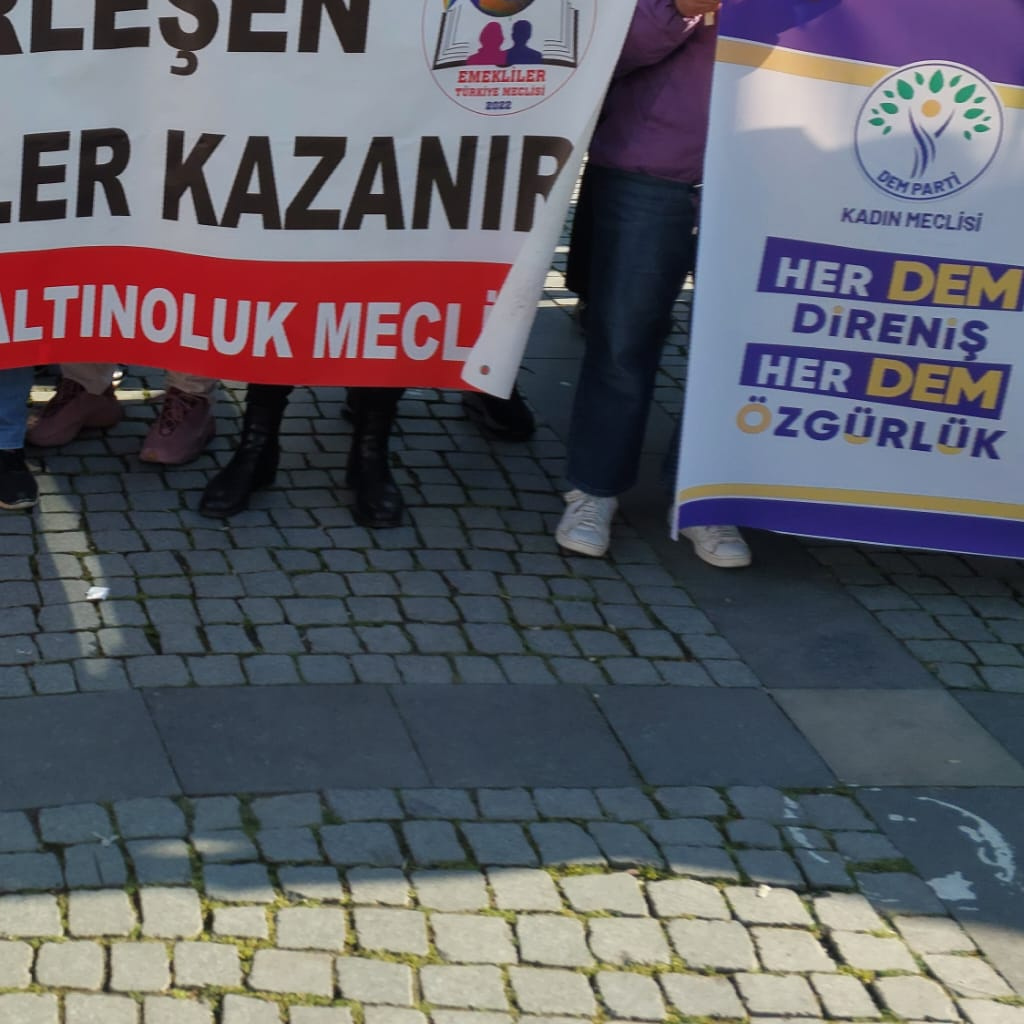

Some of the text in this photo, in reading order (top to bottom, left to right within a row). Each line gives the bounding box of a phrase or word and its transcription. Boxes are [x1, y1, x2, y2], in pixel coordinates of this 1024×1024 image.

[457, 66, 546, 83] EMEKLİLER
[455, 85, 499, 97] TÜRKİYE
[485, 100, 512, 110] 2022
[162, 128, 574, 233] KAZANIR
[877, 170, 962, 195] DEM PARTİ
[840, 207, 984, 232] KADIN MECLİSİ
[775, 257, 1023, 310] HER DEM
[757, 354, 1003, 410] HER DEM
[736, 395, 1008, 460] ÖZGÜRLÜK
